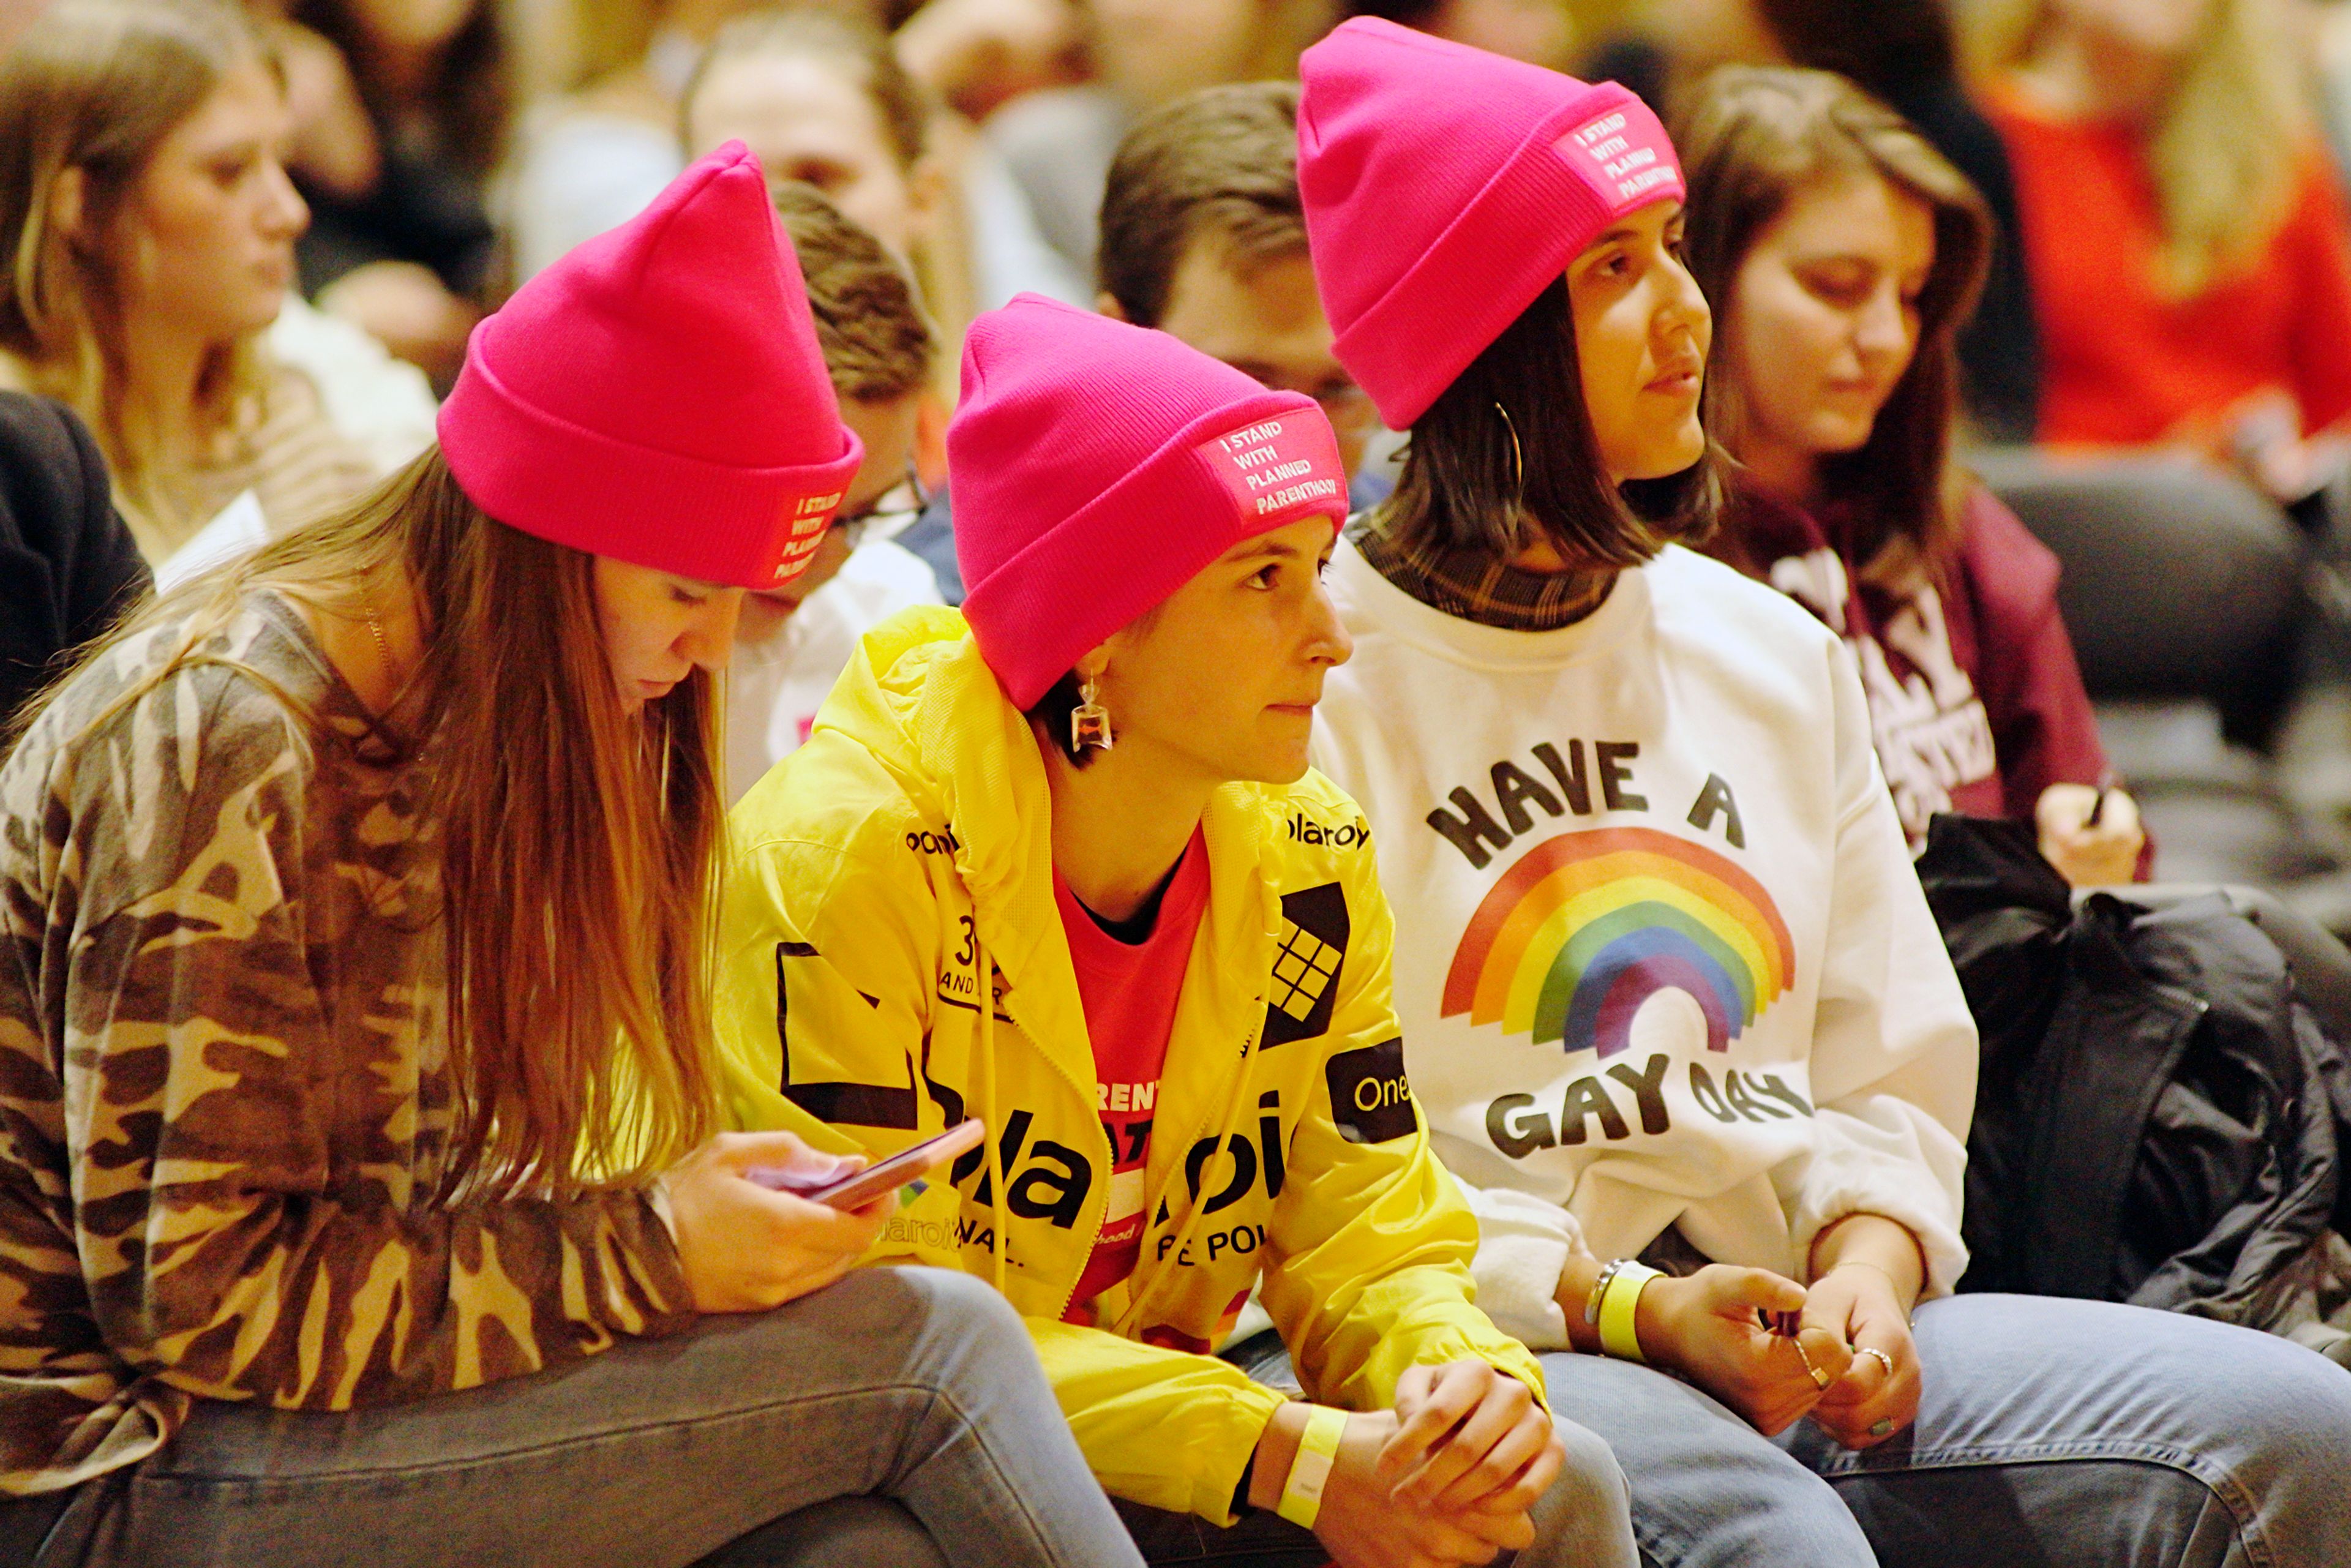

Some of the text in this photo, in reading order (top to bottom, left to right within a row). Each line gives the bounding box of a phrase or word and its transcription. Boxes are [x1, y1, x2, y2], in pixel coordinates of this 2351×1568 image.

[1574, 113, 1627, 147] I STAND
[1589, 135, 1629, 162] WITH
[1220, 421, 1282, 453] I STAND
[1233, 445, 1278, 470] WITH
[1245, 459, 1312, 490] PLANNED
[1426, 738, 1745, 870] HAVE A
[1486, 1053, 1815, 1159] GAY DAY
